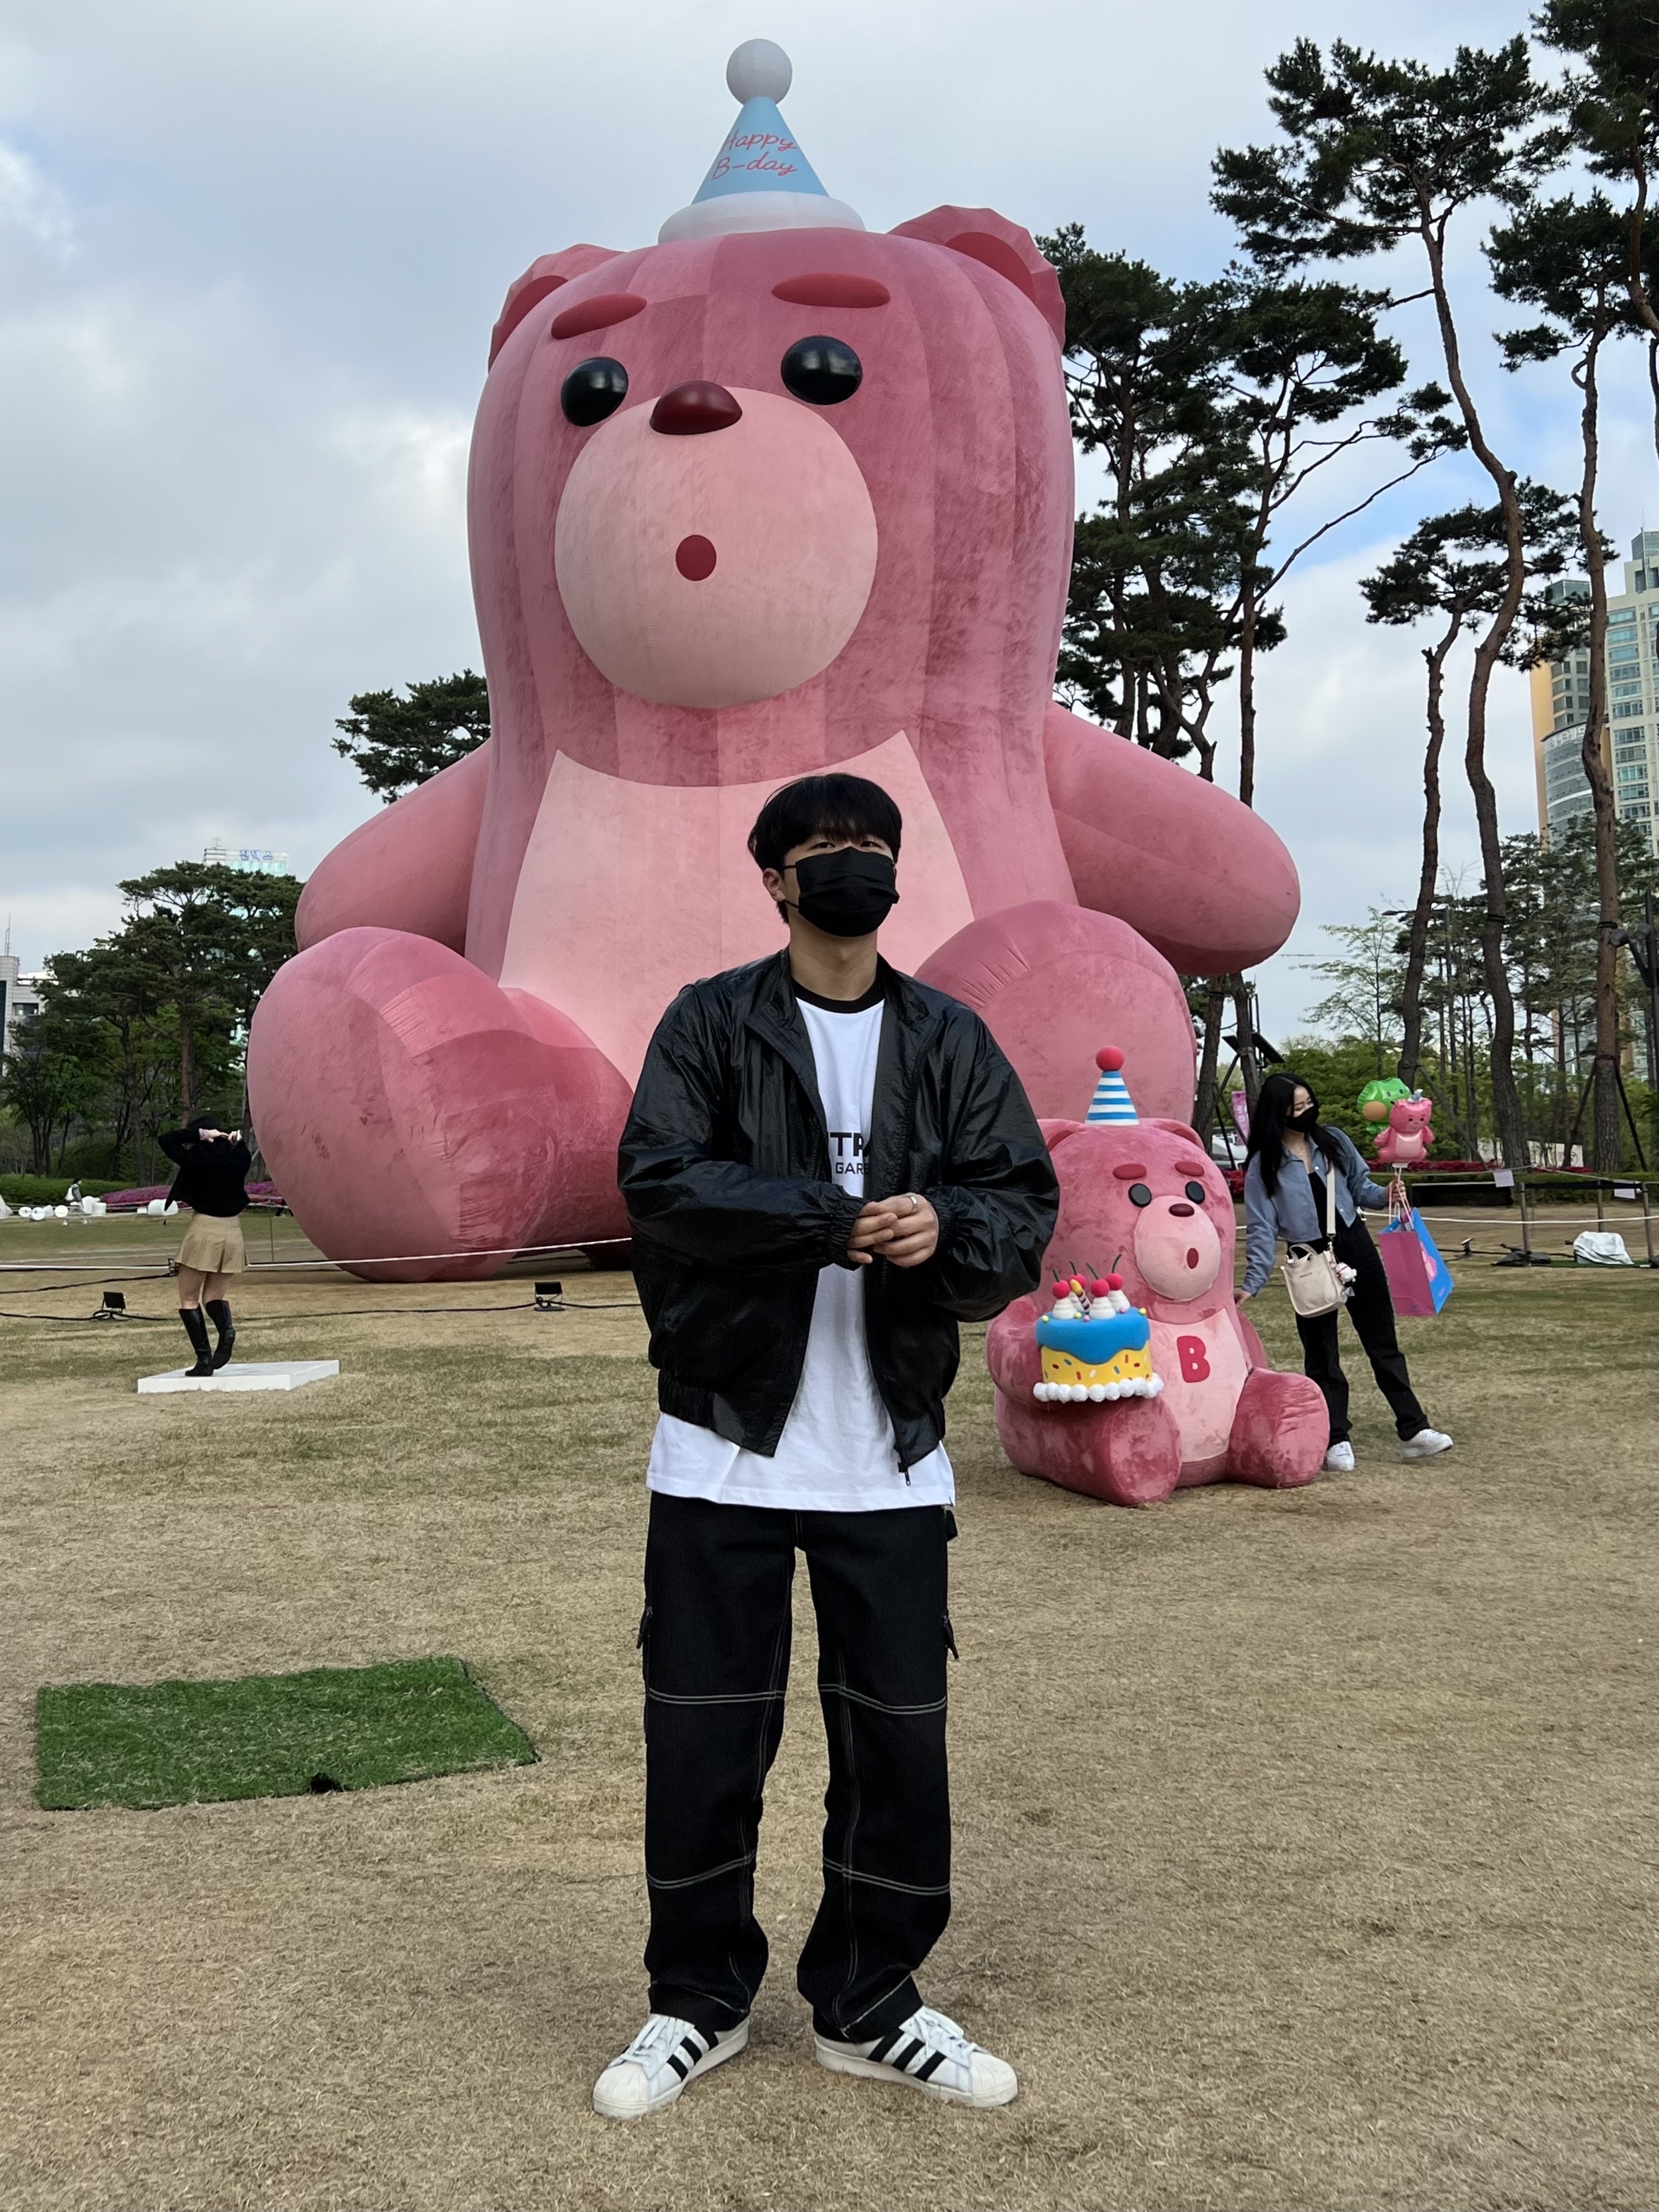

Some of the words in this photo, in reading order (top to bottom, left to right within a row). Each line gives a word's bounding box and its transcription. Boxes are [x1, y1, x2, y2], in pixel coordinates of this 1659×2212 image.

[720, 129, 798, 152] Happy
[711, 152, 798, 180] B-day
[835, 1162, 868, 1175] GAR
[1177, 1336, 1210, 1383] B
